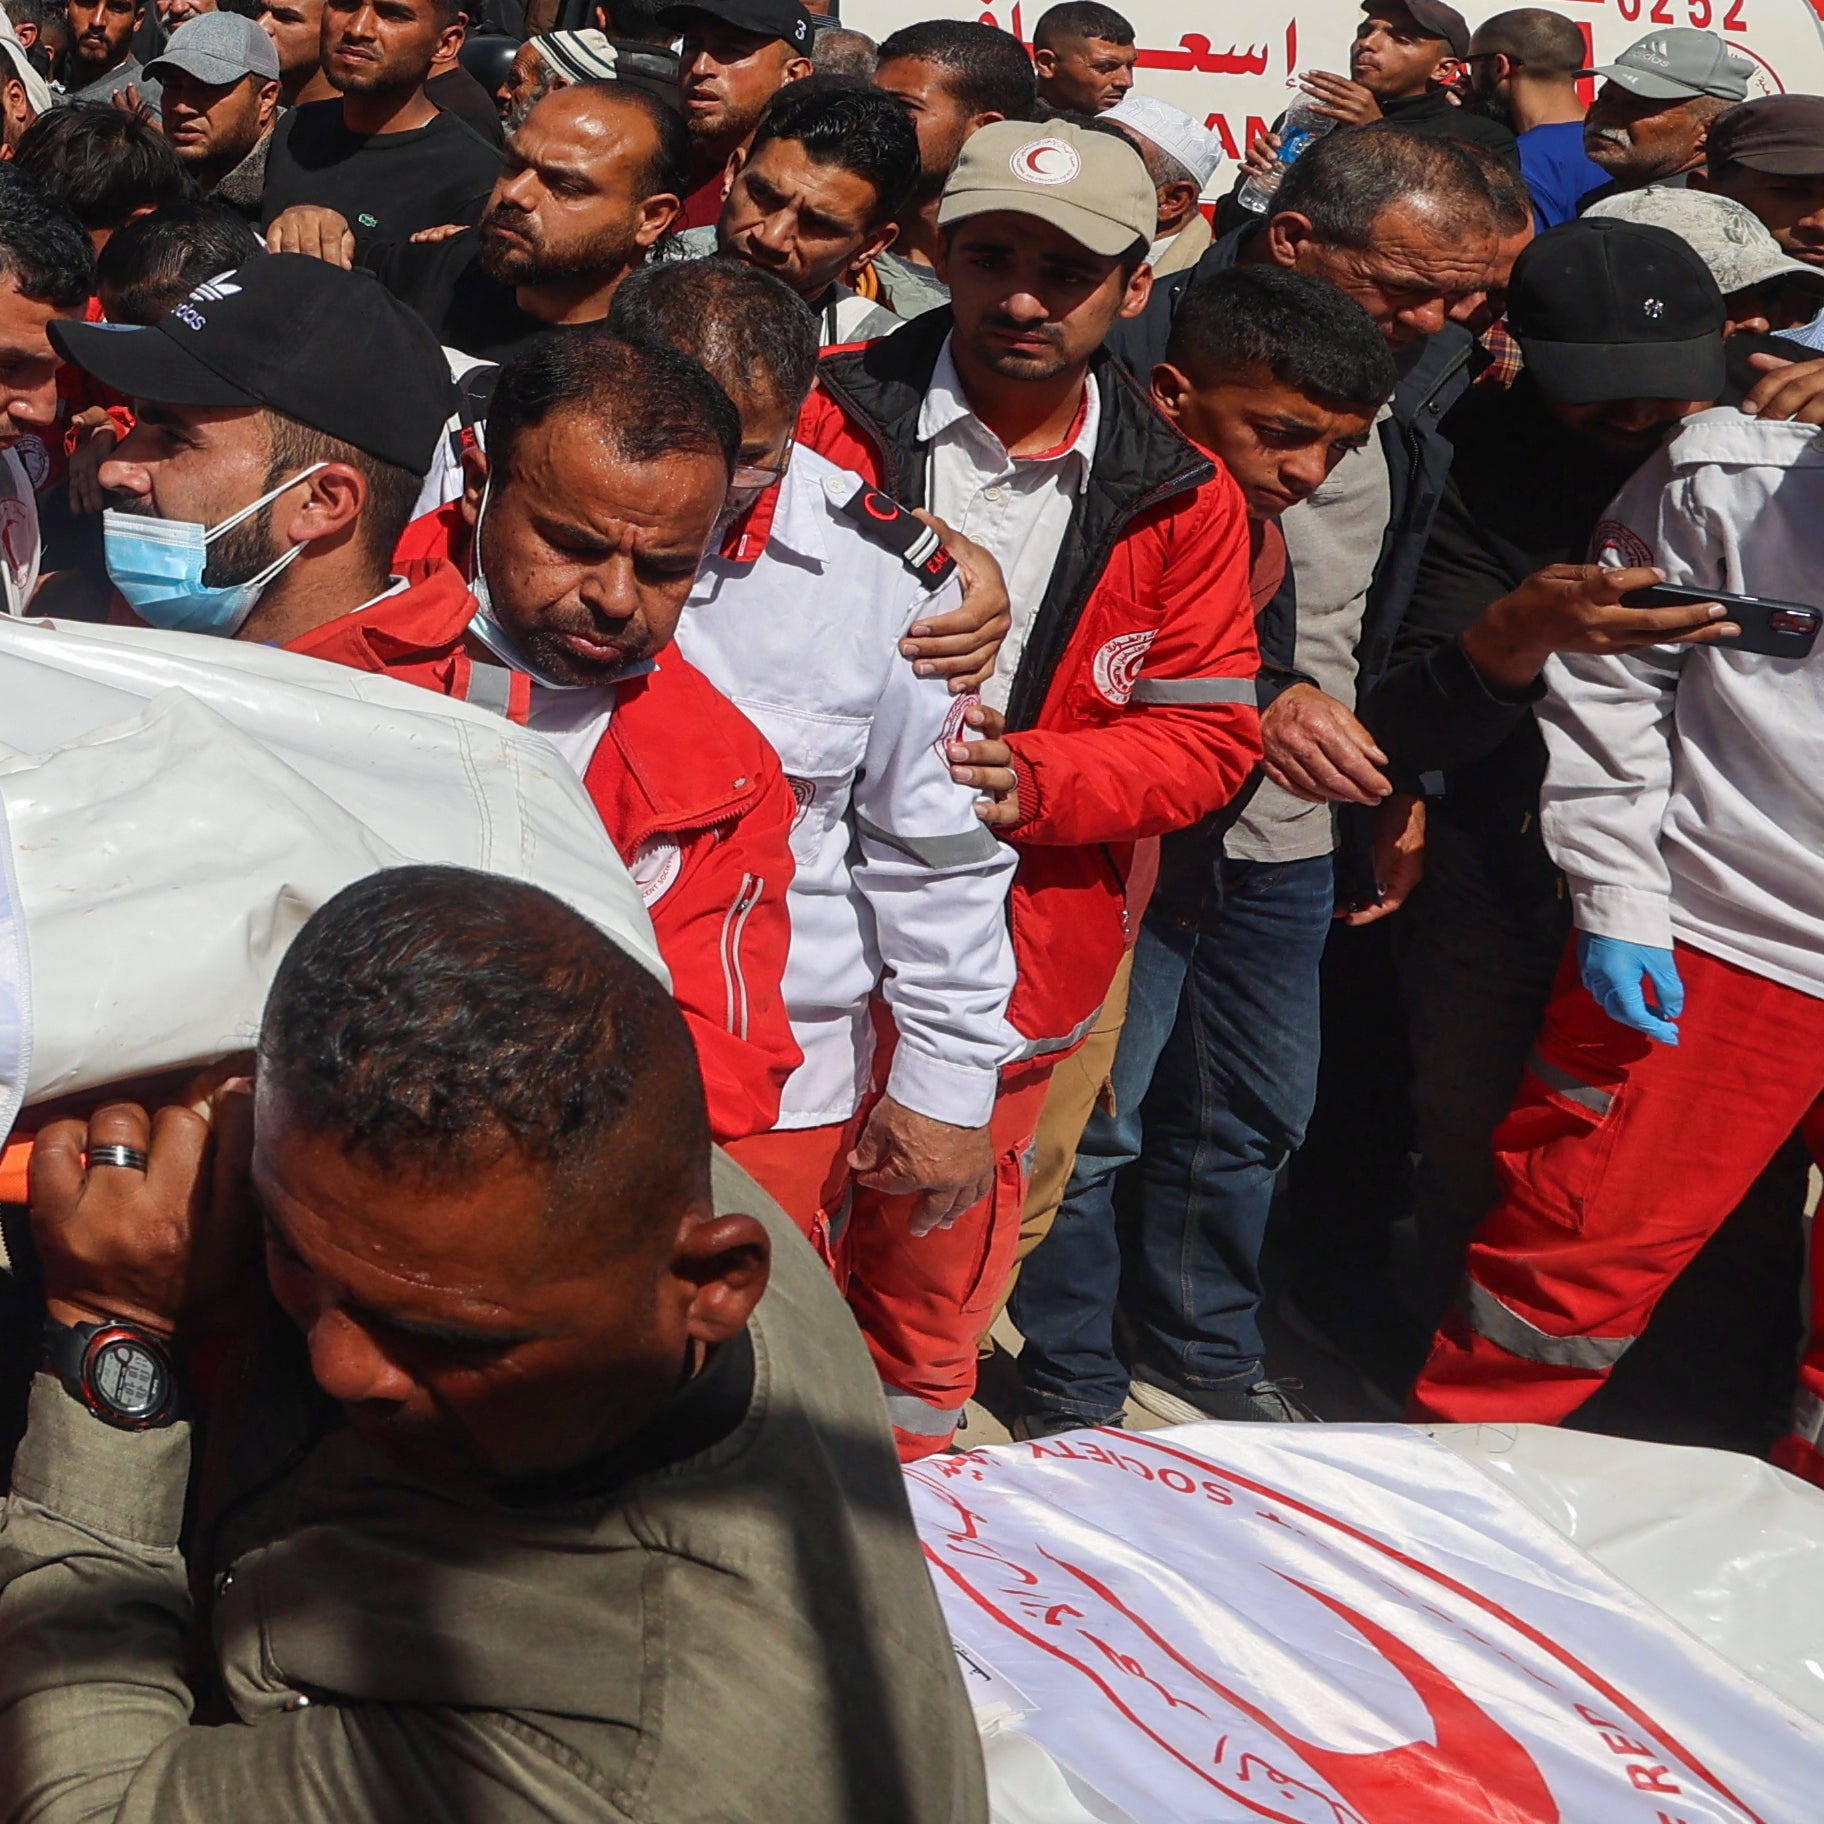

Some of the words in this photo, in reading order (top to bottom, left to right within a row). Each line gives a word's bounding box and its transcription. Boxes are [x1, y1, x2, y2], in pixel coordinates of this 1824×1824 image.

[795, 19, 808, 41] 3
[1024, 1441, 1235, 1506] SOCIETY
[1587, 1700, 1683, 1796] RED
